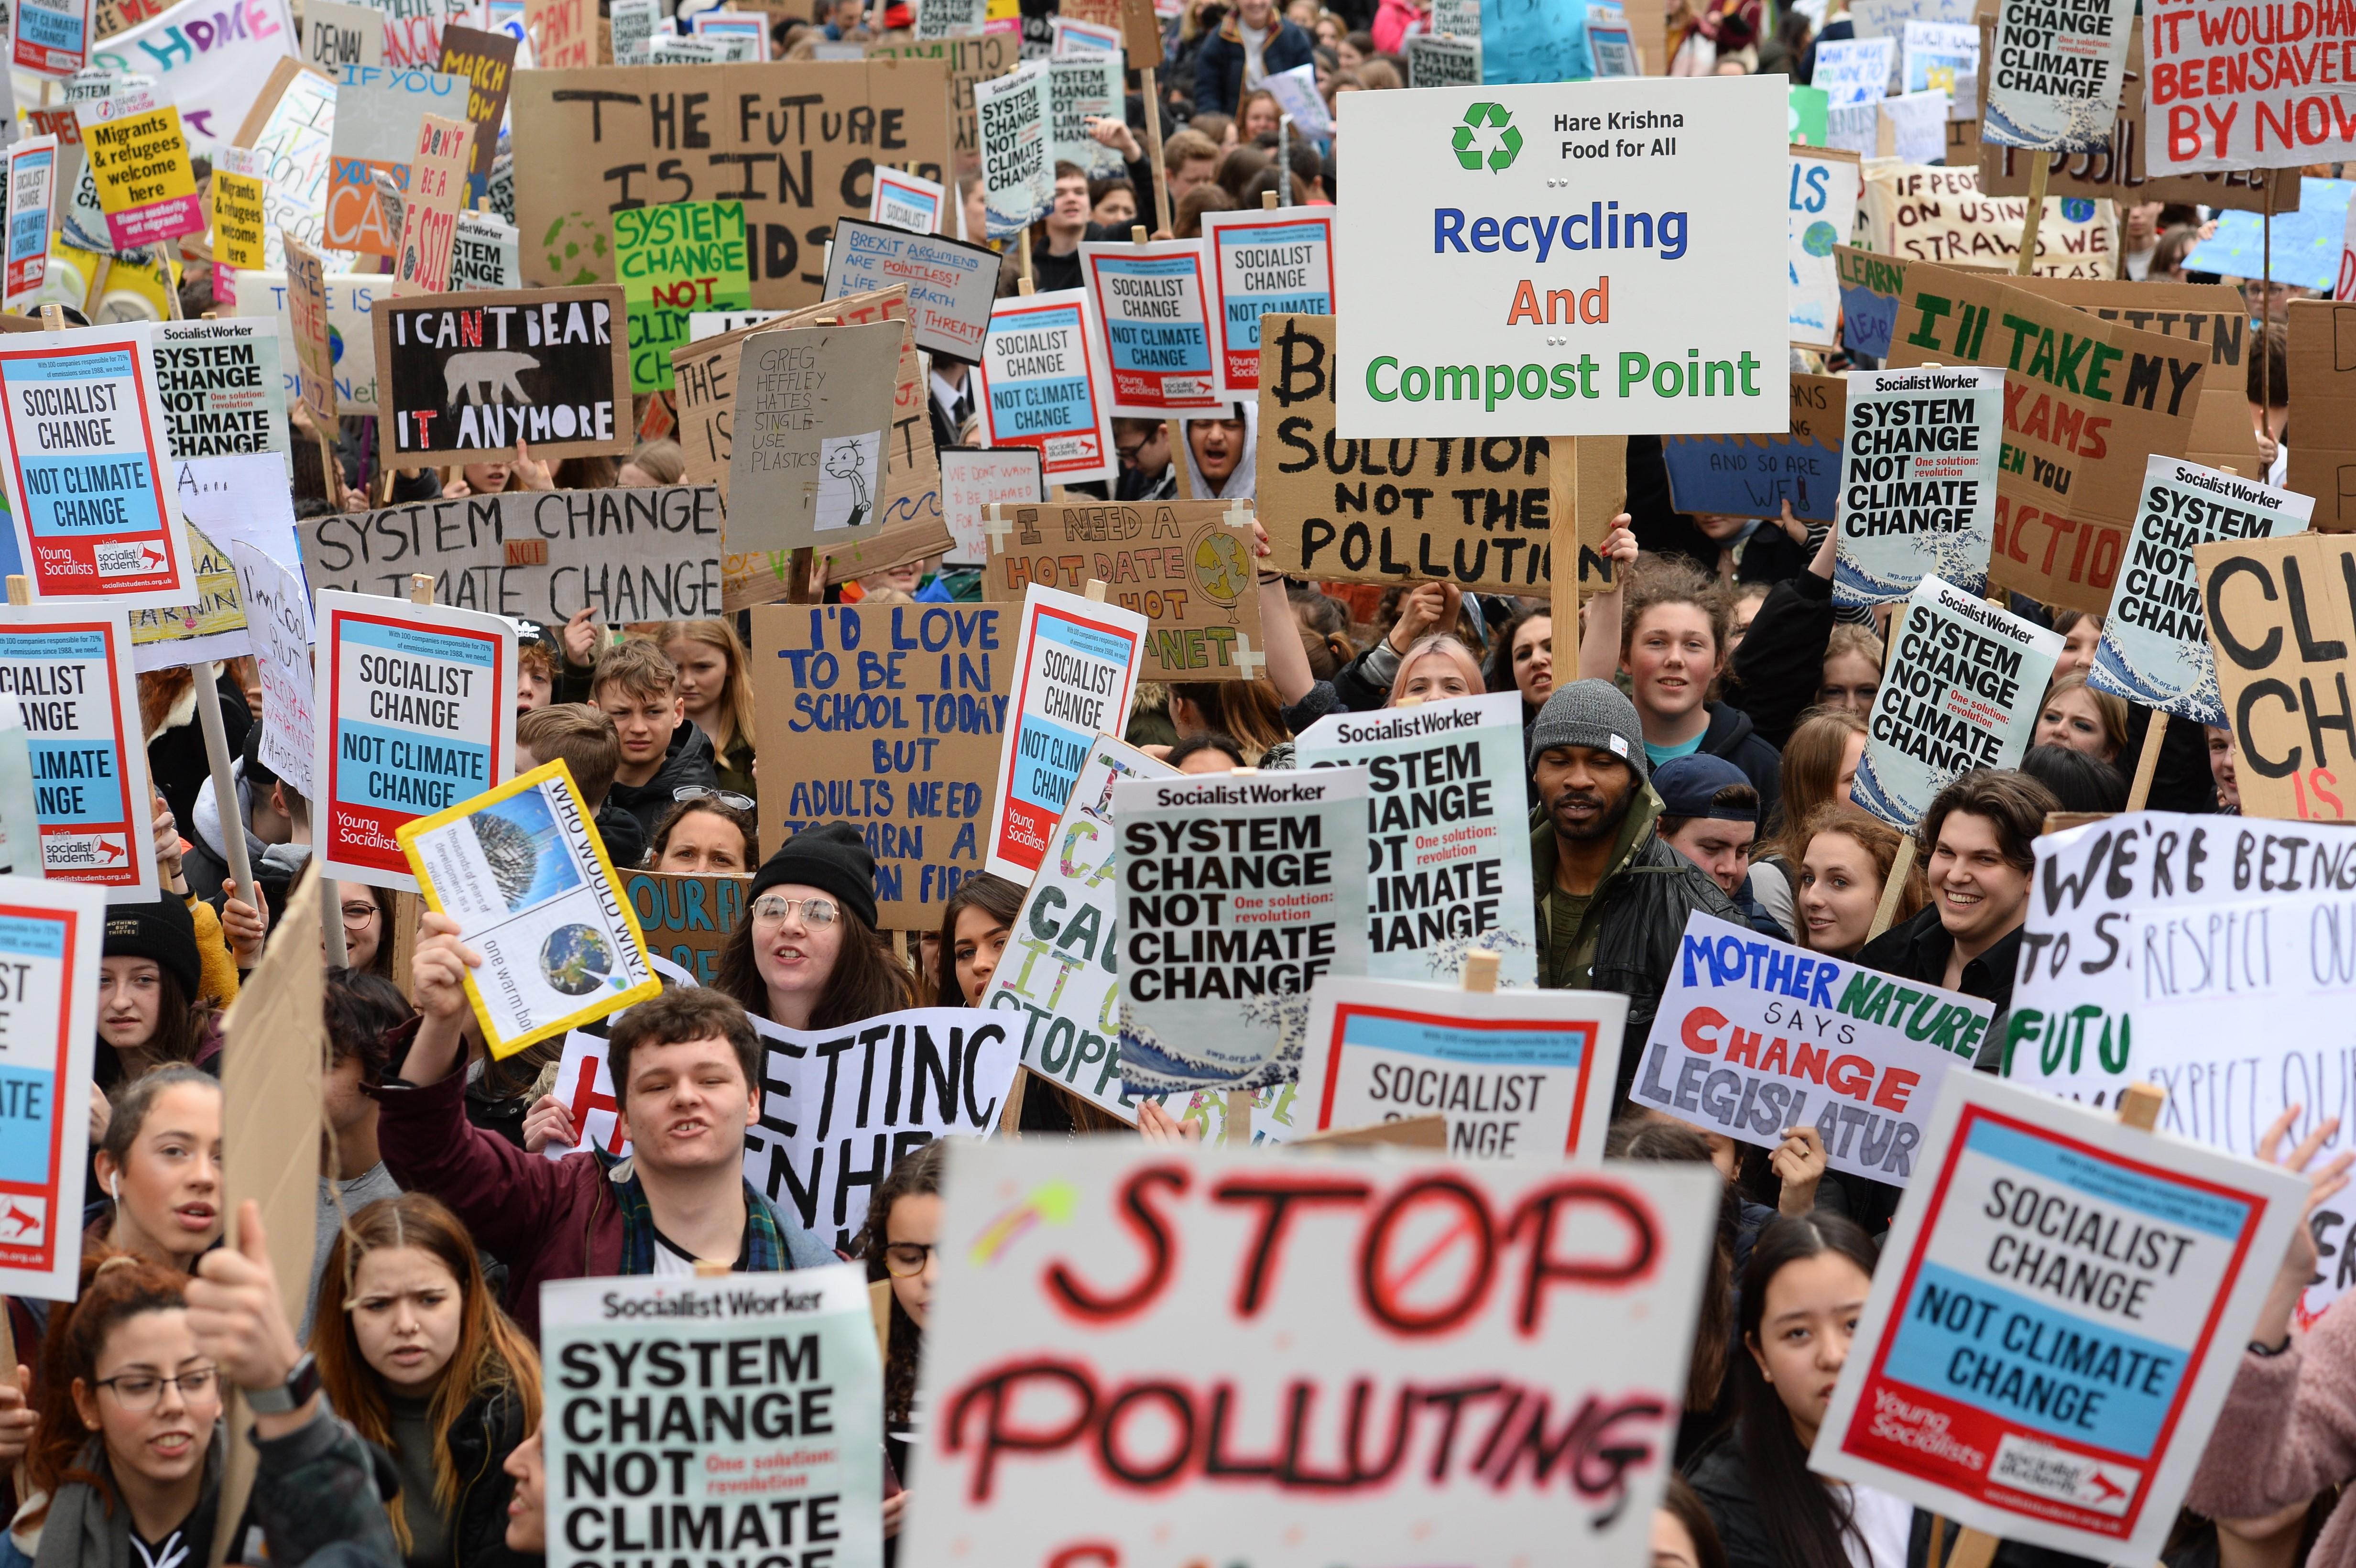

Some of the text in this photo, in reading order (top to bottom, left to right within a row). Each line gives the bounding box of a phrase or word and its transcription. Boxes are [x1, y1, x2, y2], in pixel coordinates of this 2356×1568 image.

[2004, 25, 2054, 50] NOT
[2152, 4, 2314, 58] IT WOULD
[339, 65, 453, 96] IF YOU
[2000, 49, 2109, 79] CLIMATE
[2152, 53, 2248, 105] BEEN
[1997, 70, 2102, 98] CHANGE
[552, 90, 907, 150] THE FUTURE
[982, 86, 1037, 120] SYSTEM
[95, 117, 167, 146] Migrants
[984, 103, 1039, 138] CHANGE
[1553, 111, 1684, 132] Hare Krishna
[2169, 101, 2238, 162] BY
[95, 136, 180, 168] & refugees
[420, 123, 465, 159] DON'T
[986, 133, 1016, 156] NOT
[987, 139, 1044, 175] CLIMATE
[1561, 138, 1677, 159] Food for All
[107, 159, 176, 185] welcome
[421, 167, 445, 196] BE A
[604, 150, 813, 215] IS IN
[988, 156, 1043, 192] CHANGE
[1897, 175, 1922, 196] IF
[129, 183, 164, 203] here
[615, 202, 744, 250] SYSTEM
[1898, 202, 1941, 227] ON
[1434, 201, 1688, 263] Recycling
[2062, 227, 2108, 253] WE
[622, 241, 744, 278] CHANGE
[845, 254, 875, 269] ARE
[653, 278, 718, 308] NOT
[910, 288, 955, 307] EARTH
[1507, 276, 1609, 326] And
[395, 302, 611, 349] I CAN'T BEAR
[759, 346, 814, 371] GREG
[996, 331, 1068, 356] SOCIALIST
[757, 371, 826, 392] HEFFLEY
[1007, 354, 1065, 377] CHANGE
[1366, 349, 1761, 412] Compost Point
[2002, 313, 2203, 416] TAKE MY
[23, 383, 117, 417] SOCIALIST
[757, 393, 812, 410] HATES
[993, 381, 1086, 409] NOT CLIMATE
[398, 402, 613, 449] IT ANYMORE
[1014, 407, 1071, 430] CHANGE
[1852, 399, 1974, 428] SYSTEM
[38, 418, 115, 449] CHANGE
[753, 434, 785, 449] USE
[1851, 426, 1979, 455] CHANGE
[26, 461, 146, 495] NOT CLIMATE
[751, 451, 819, 473] PLASTICS
[1711, 454, 1821, 475] AND SO ARE
[1849, 455, 1910, 483] NOT
[1914, 468, 1963, 477] revolution
[1915, 457, 1978, 467] One solution:
[2033, 455, 2072, 495] YOU
[54, 497, 128, 527] CHANGE
[1335, 482, 1551, 532] NOT THE
[1847, 481, 1978, 510] CLIMATE
[316, 489, 717, 571] SYSTEM CHANGE
[1017, 507, 1180, 544] I NEED A
[1845, 508, 1974, 537] CHANGE
[37, 545, 71, 562] Young
[44, 562, 93, 575] Socialists
[98, 550, 136, 562] socialist
[100, 559, 140, 571] students
[509, 541, 541, 564] NOT
[1005, 546, 1185, 590] HOT DATE
[102, 577, 172, 589] socialiststudents.org.uk
[1887, 572, 1922, 581] swp.org.uk
[412, 635, 439, 644] companies
[441, 639, 470, 649] responsible
[810, 607, 999, 653] I'D LOVE
[404, 643, 434, 653] emmissions
[778, 650, 991, 692] TO BE IN
[788, 694, 1009, 734] SCHOOL TODAY
[872, 738, 939, 773] BUT
[789, 779, 982, 818] ADULTS NEED
[426, 861, 450, 906] civilization
[435, 843, 464, 895] development
[458, 895, 468, 906] as
[447, 828, 491, 913] thousands of years of
[552, 782, 649, 976] WHO WOULD WIN?
[2042, 820, 2208, 916] WE'RE
[2145, 908, 2272, 1000] RESPECT
[484, 940, 537, 1032] one warm boi
[1683, 934, 1840, 1011] MOTHER
[1765, 1002, 1855, 1044] SAYS
[1837, 971, 1989, 1060] NATURE
[1680, 1006, 1920, 1113] CHANGE
[1984, 1177, 2194, 1277] SOCIALIST
[1042, 1164, 1664, 1340] STOP
[1986, 1236, 2154, 1321] CHANGE
[1916, 1284, 2173, 1397] NOT CLIMATE
[1947, 1347, 2107, 1431] CHANGE
[944, 1355, 1668, 1530] POLLUTING
